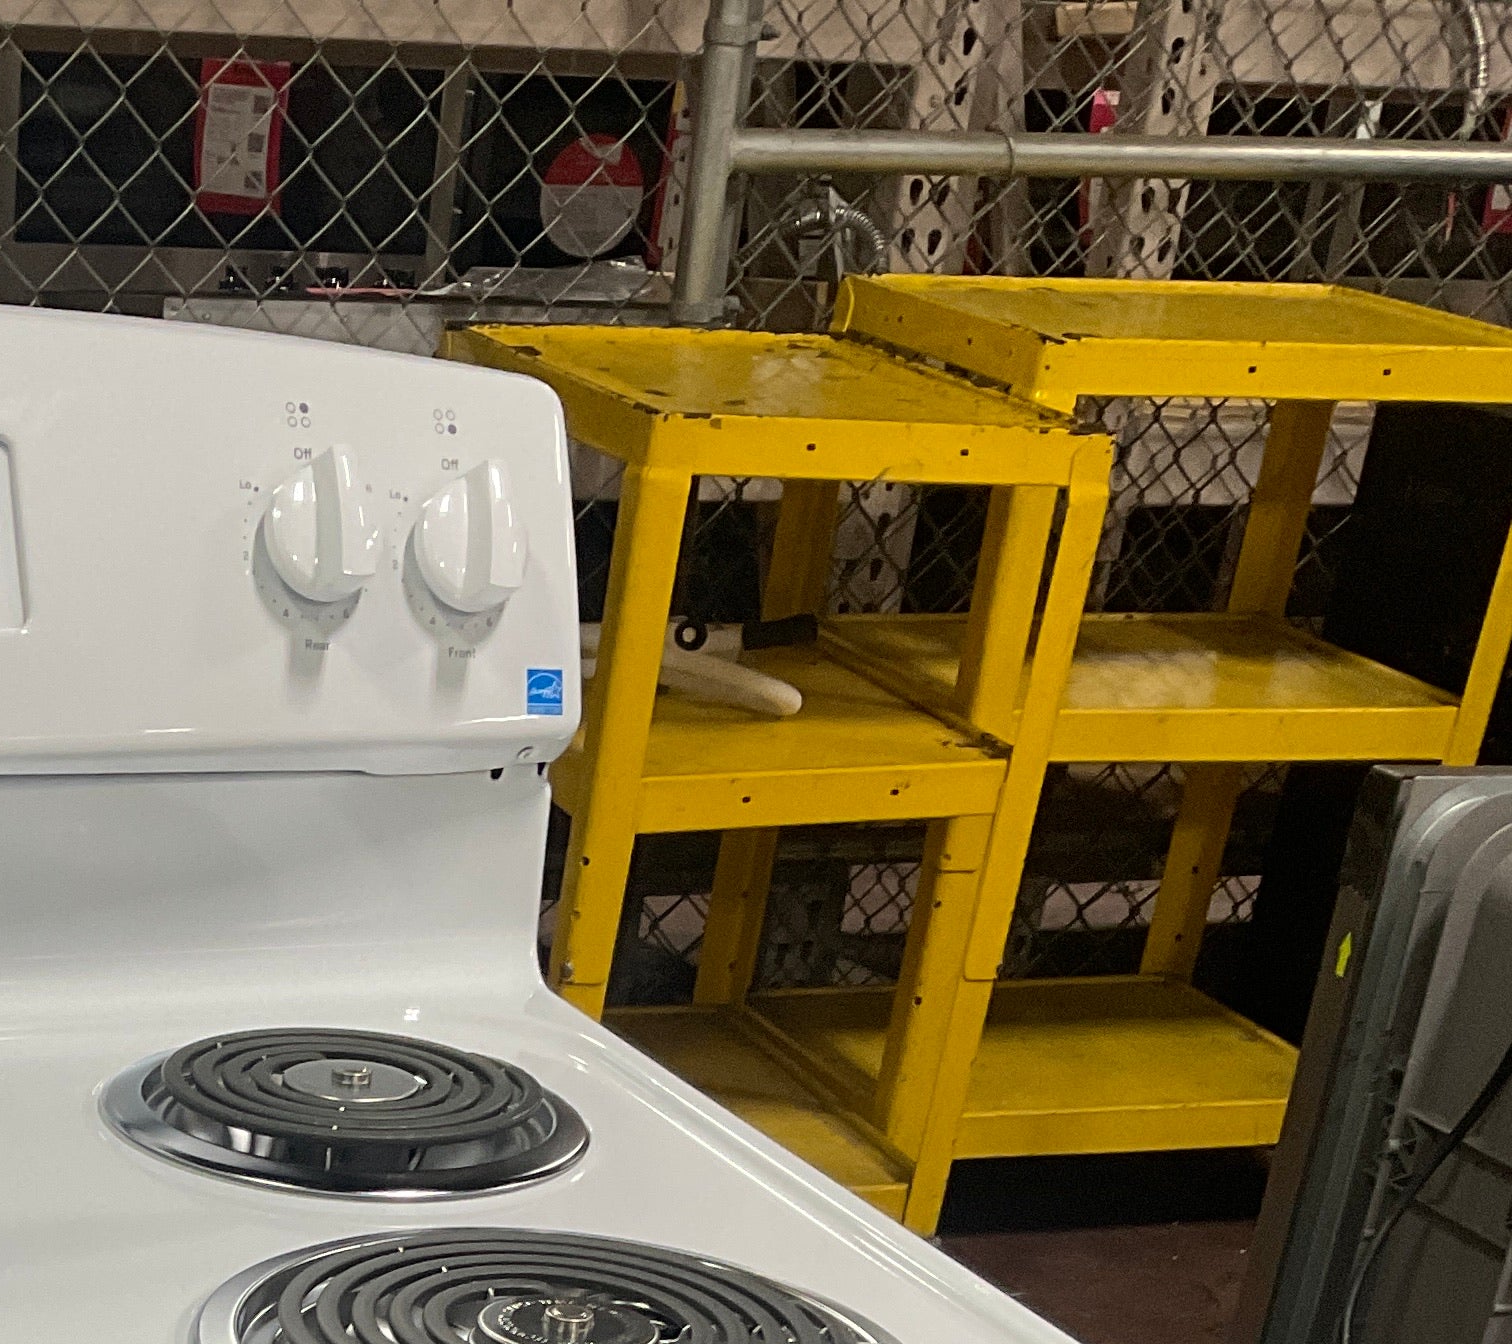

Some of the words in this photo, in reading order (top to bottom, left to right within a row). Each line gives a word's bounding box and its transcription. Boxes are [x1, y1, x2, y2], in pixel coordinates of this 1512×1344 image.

[293, 447, 313, 460] Off
[441, 458, 459, 470] Off
[239, 479, 252, 490] Lo
